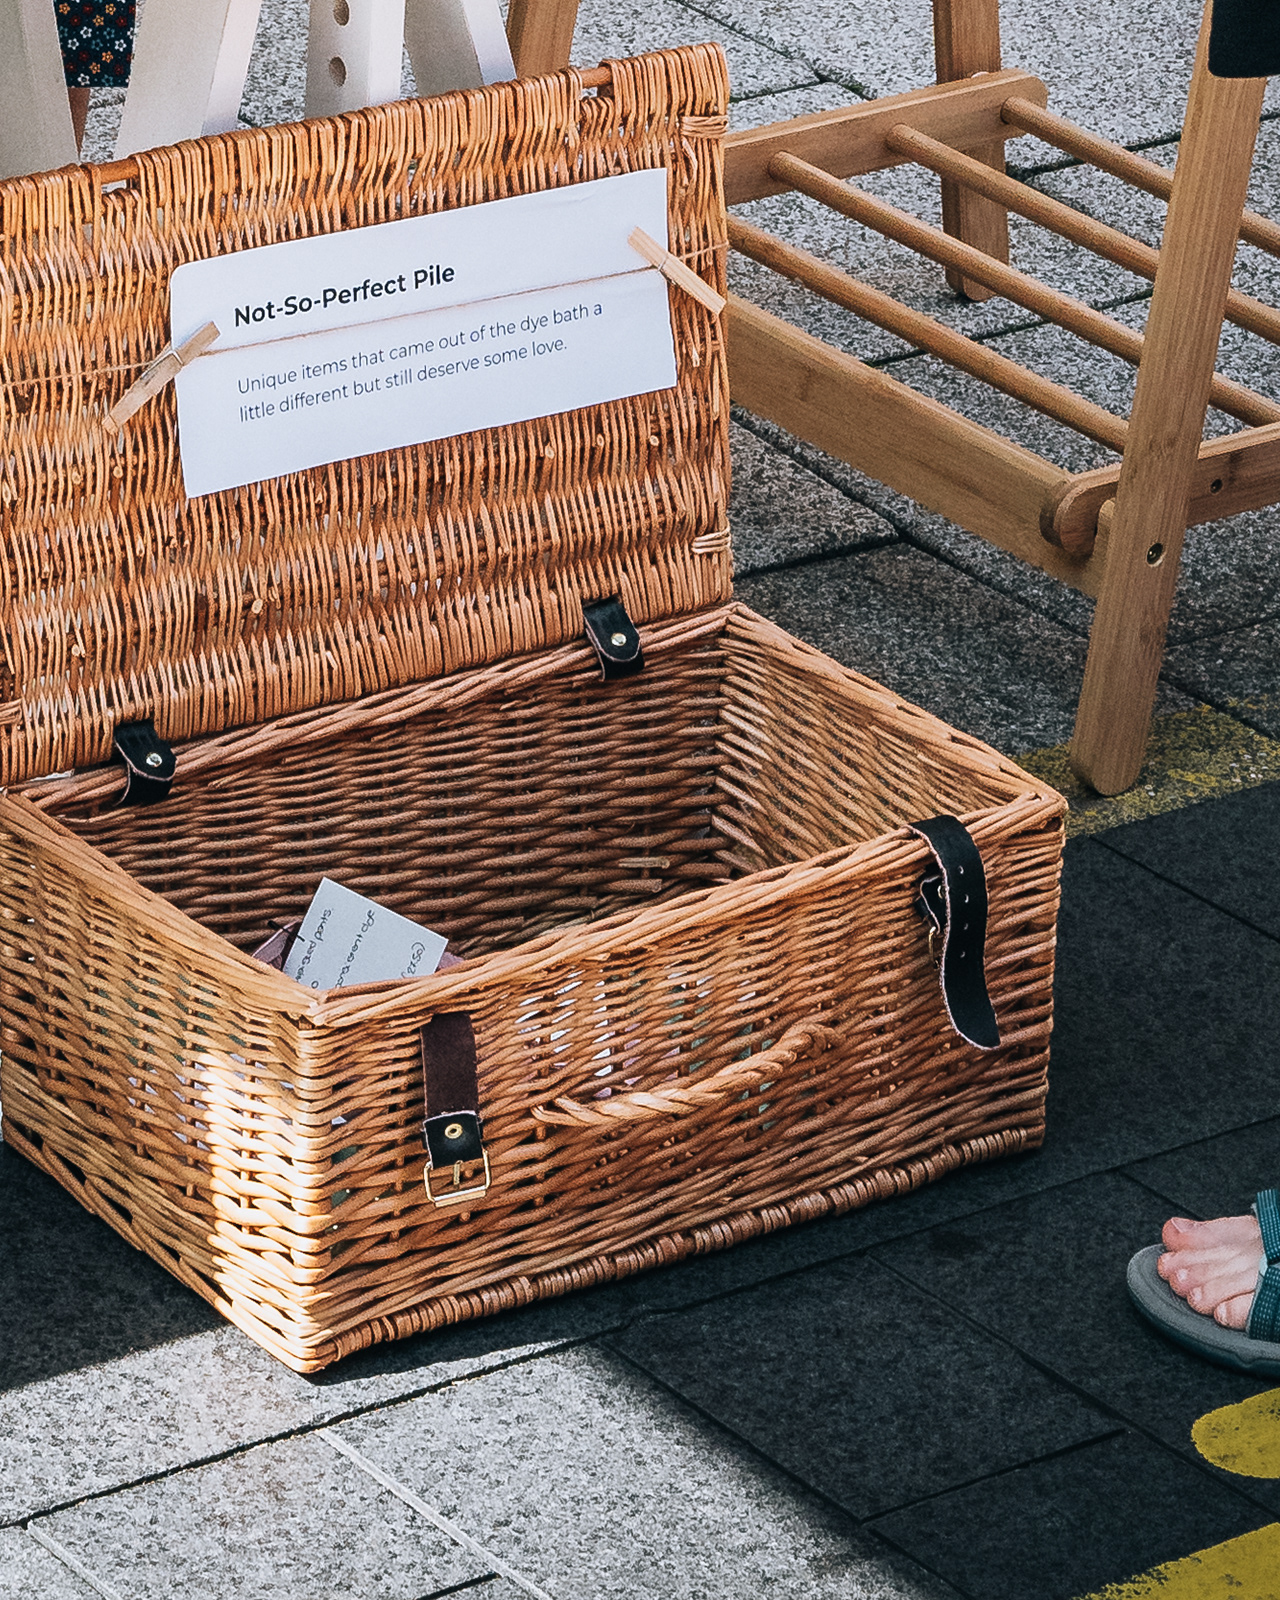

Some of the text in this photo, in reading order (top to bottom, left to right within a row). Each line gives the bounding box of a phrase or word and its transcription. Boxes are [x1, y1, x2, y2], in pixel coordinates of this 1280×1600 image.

[234, 264, 455, 327] Not-So-Perfect Pile
[238, 303, 603, 394] Unique items that came out of the dye bath a
[239, 338, 568, 423] little different but still deserve some love.
